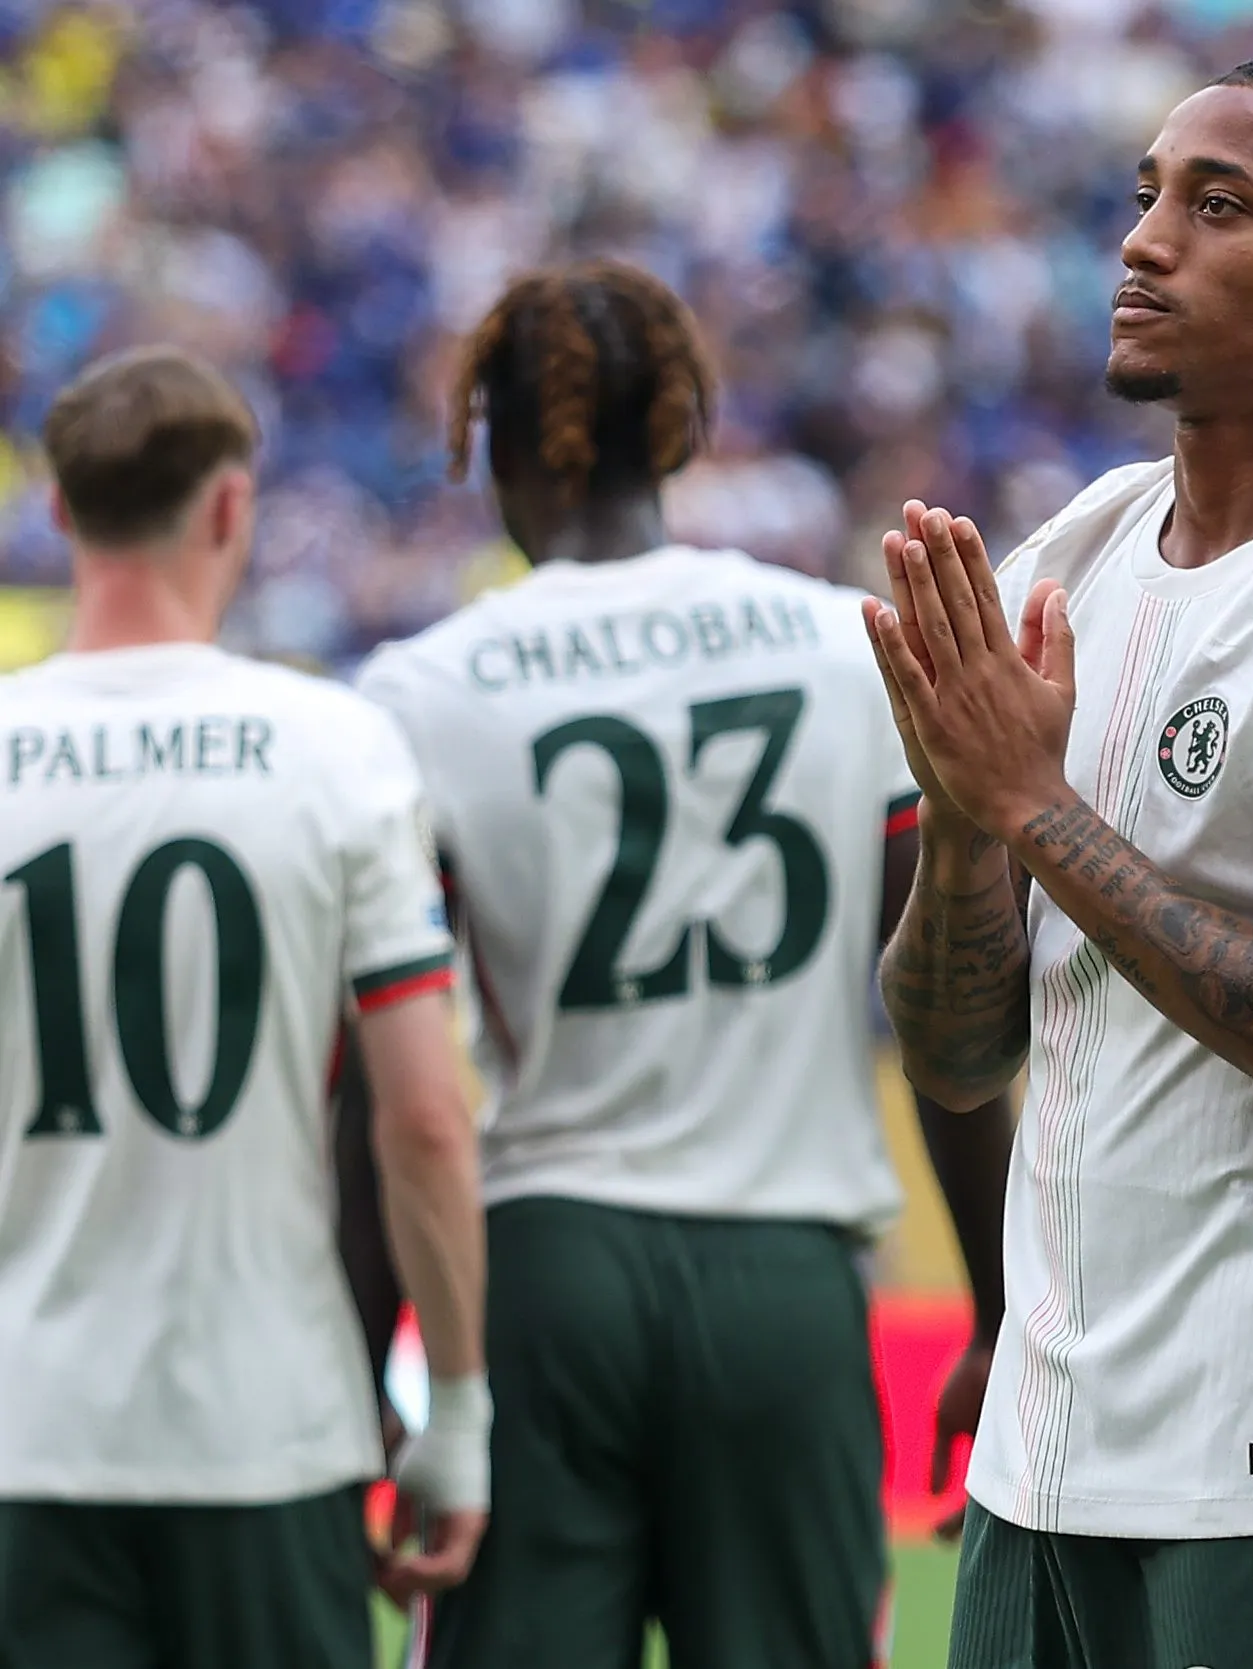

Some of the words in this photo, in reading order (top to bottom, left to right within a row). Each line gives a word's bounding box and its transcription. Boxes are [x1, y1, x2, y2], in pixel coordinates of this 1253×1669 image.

[467, 597, 820, 691] CHALOBAH
[7, 713, 274, 786] PALMER
[1182, 698, 1229, 721] CHELSEA
[532, 686, 831, 1010] 23
[4, 836, 265, 1141] 10
